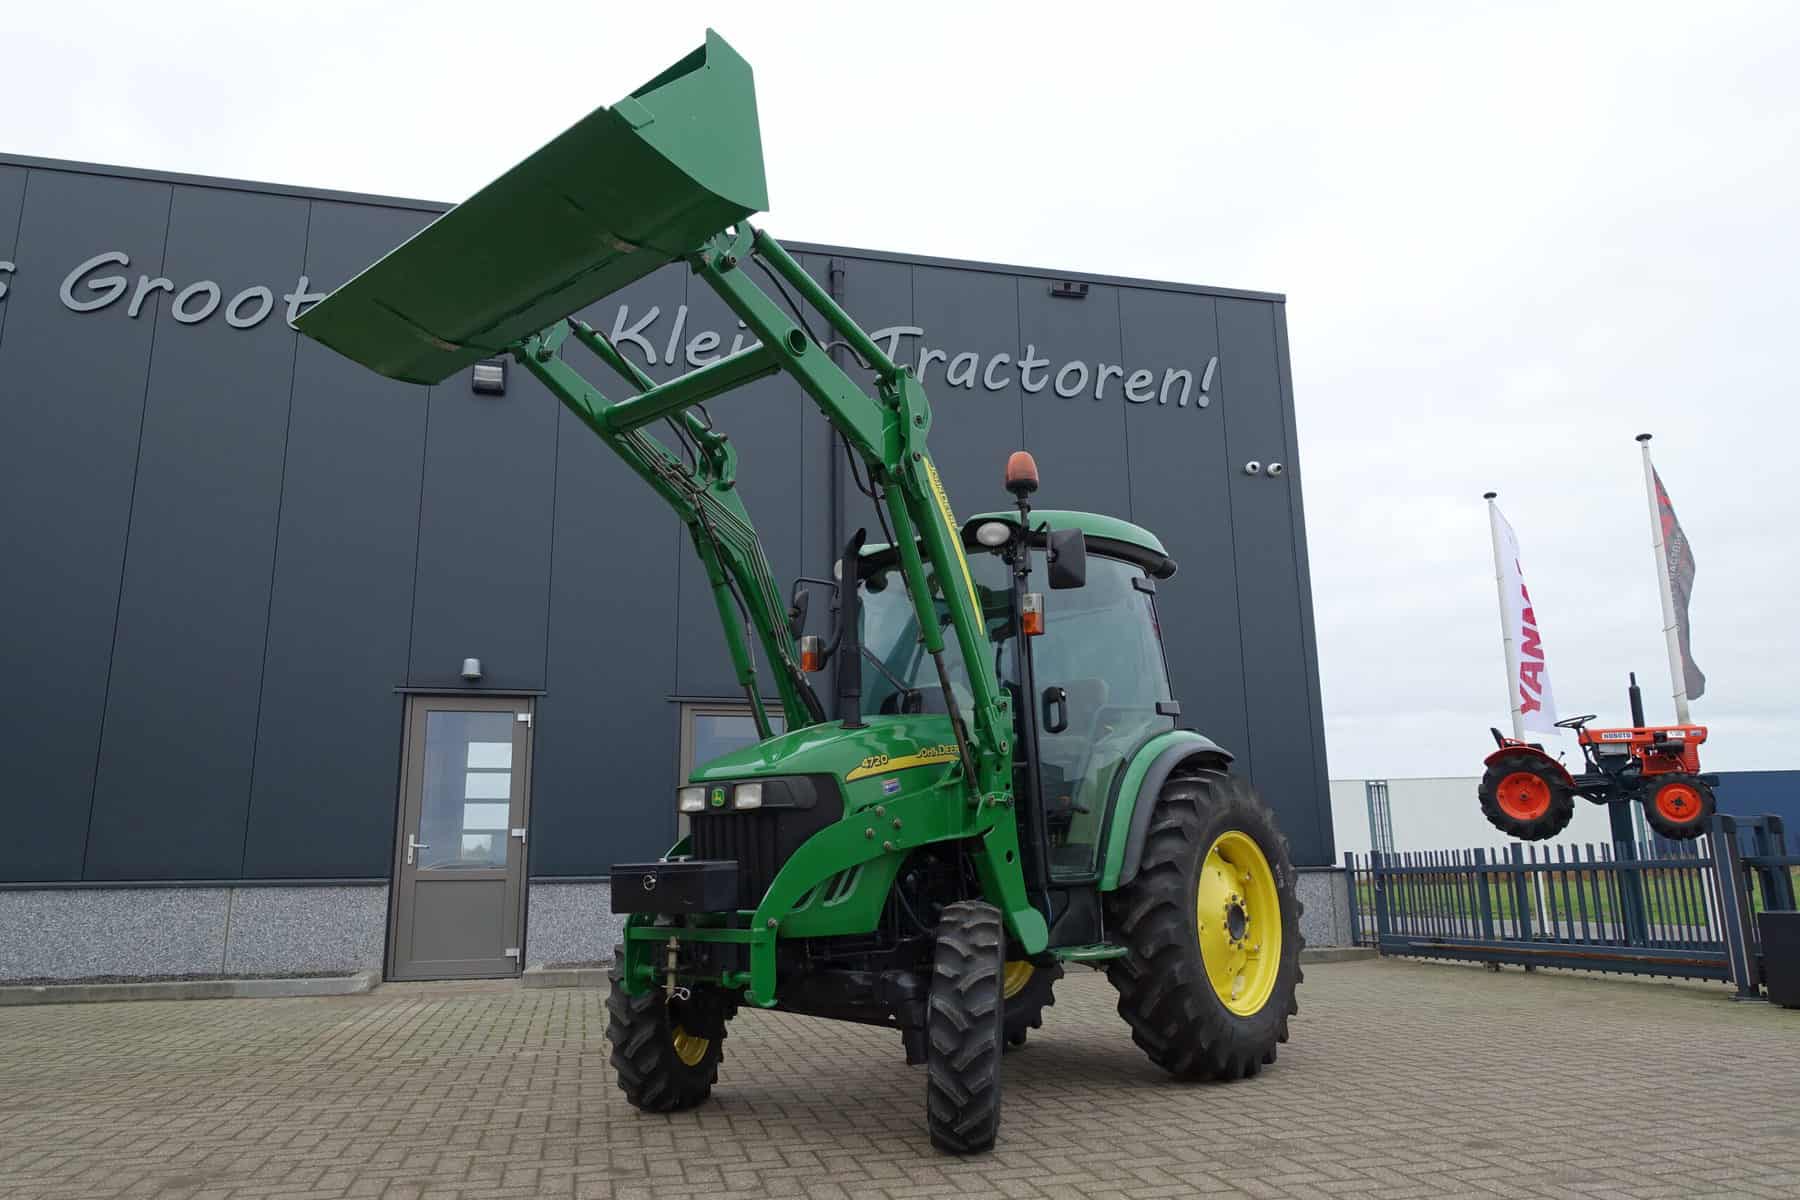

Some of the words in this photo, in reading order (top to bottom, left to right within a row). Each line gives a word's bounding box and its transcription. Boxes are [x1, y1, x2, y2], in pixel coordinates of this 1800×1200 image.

[59, 251, 328, 330] Groot
[608, 304, 764, 367] Klei
[869, 325, 1218, 408] Tractoren!
[861, 754, 888, 769] 4720
